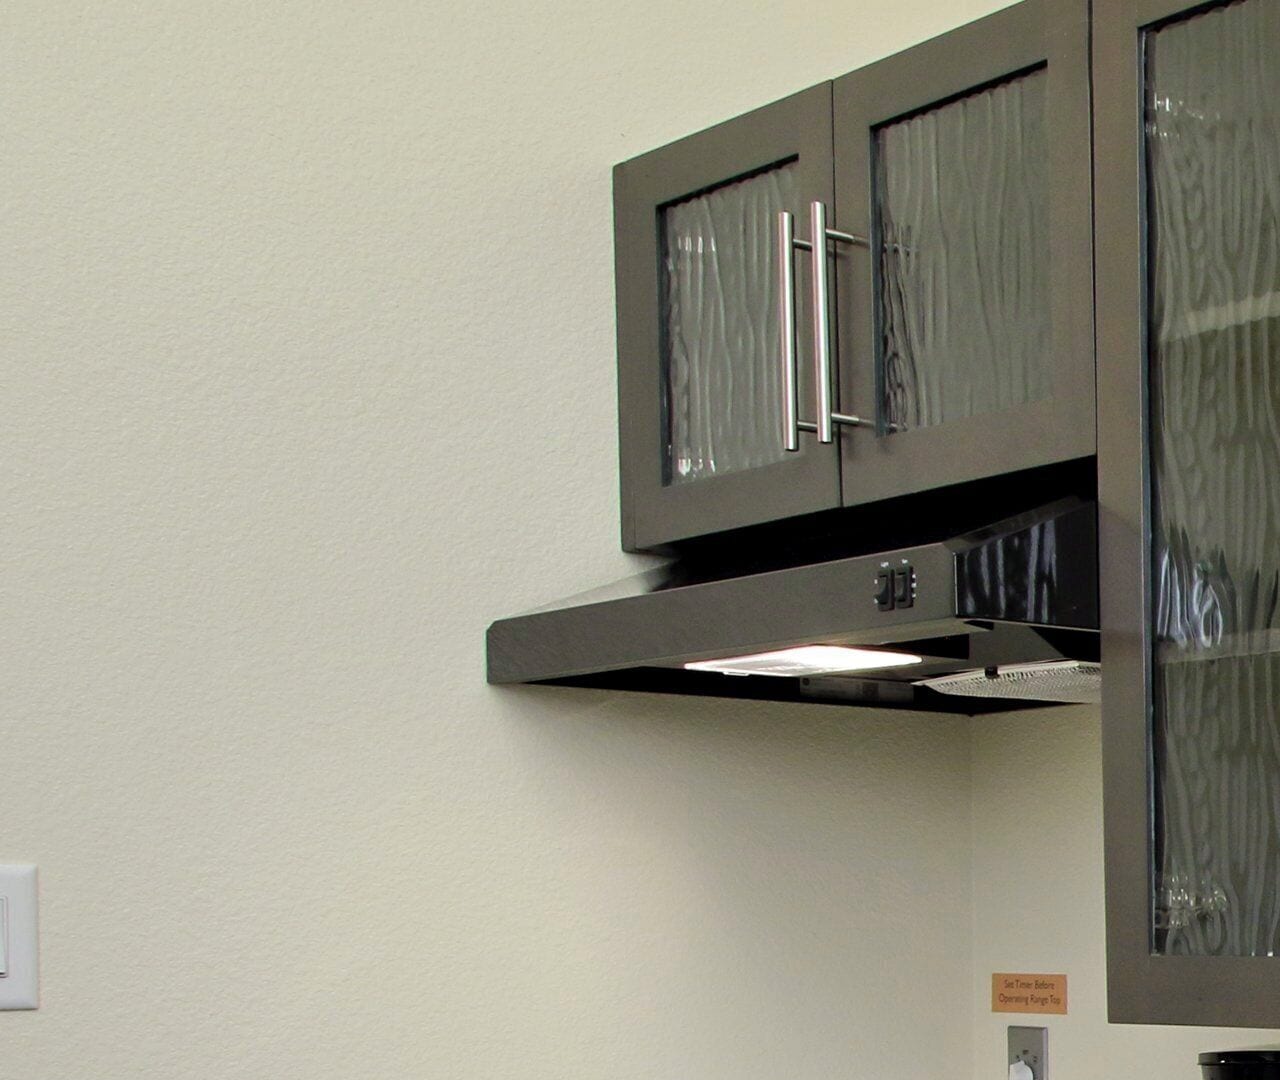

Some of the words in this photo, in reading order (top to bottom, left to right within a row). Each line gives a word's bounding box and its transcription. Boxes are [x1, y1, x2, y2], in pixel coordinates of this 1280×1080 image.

[1004, 979, 1014, 989] Set
[1015, 979, 1033, 989] Timer
[1035, 980, 1055, 990] Before
[999, 993, 1029, 1006] Operating
[1030, 994, 1049, 1006] Range
[1050, 994, 1061, 1005] Top
